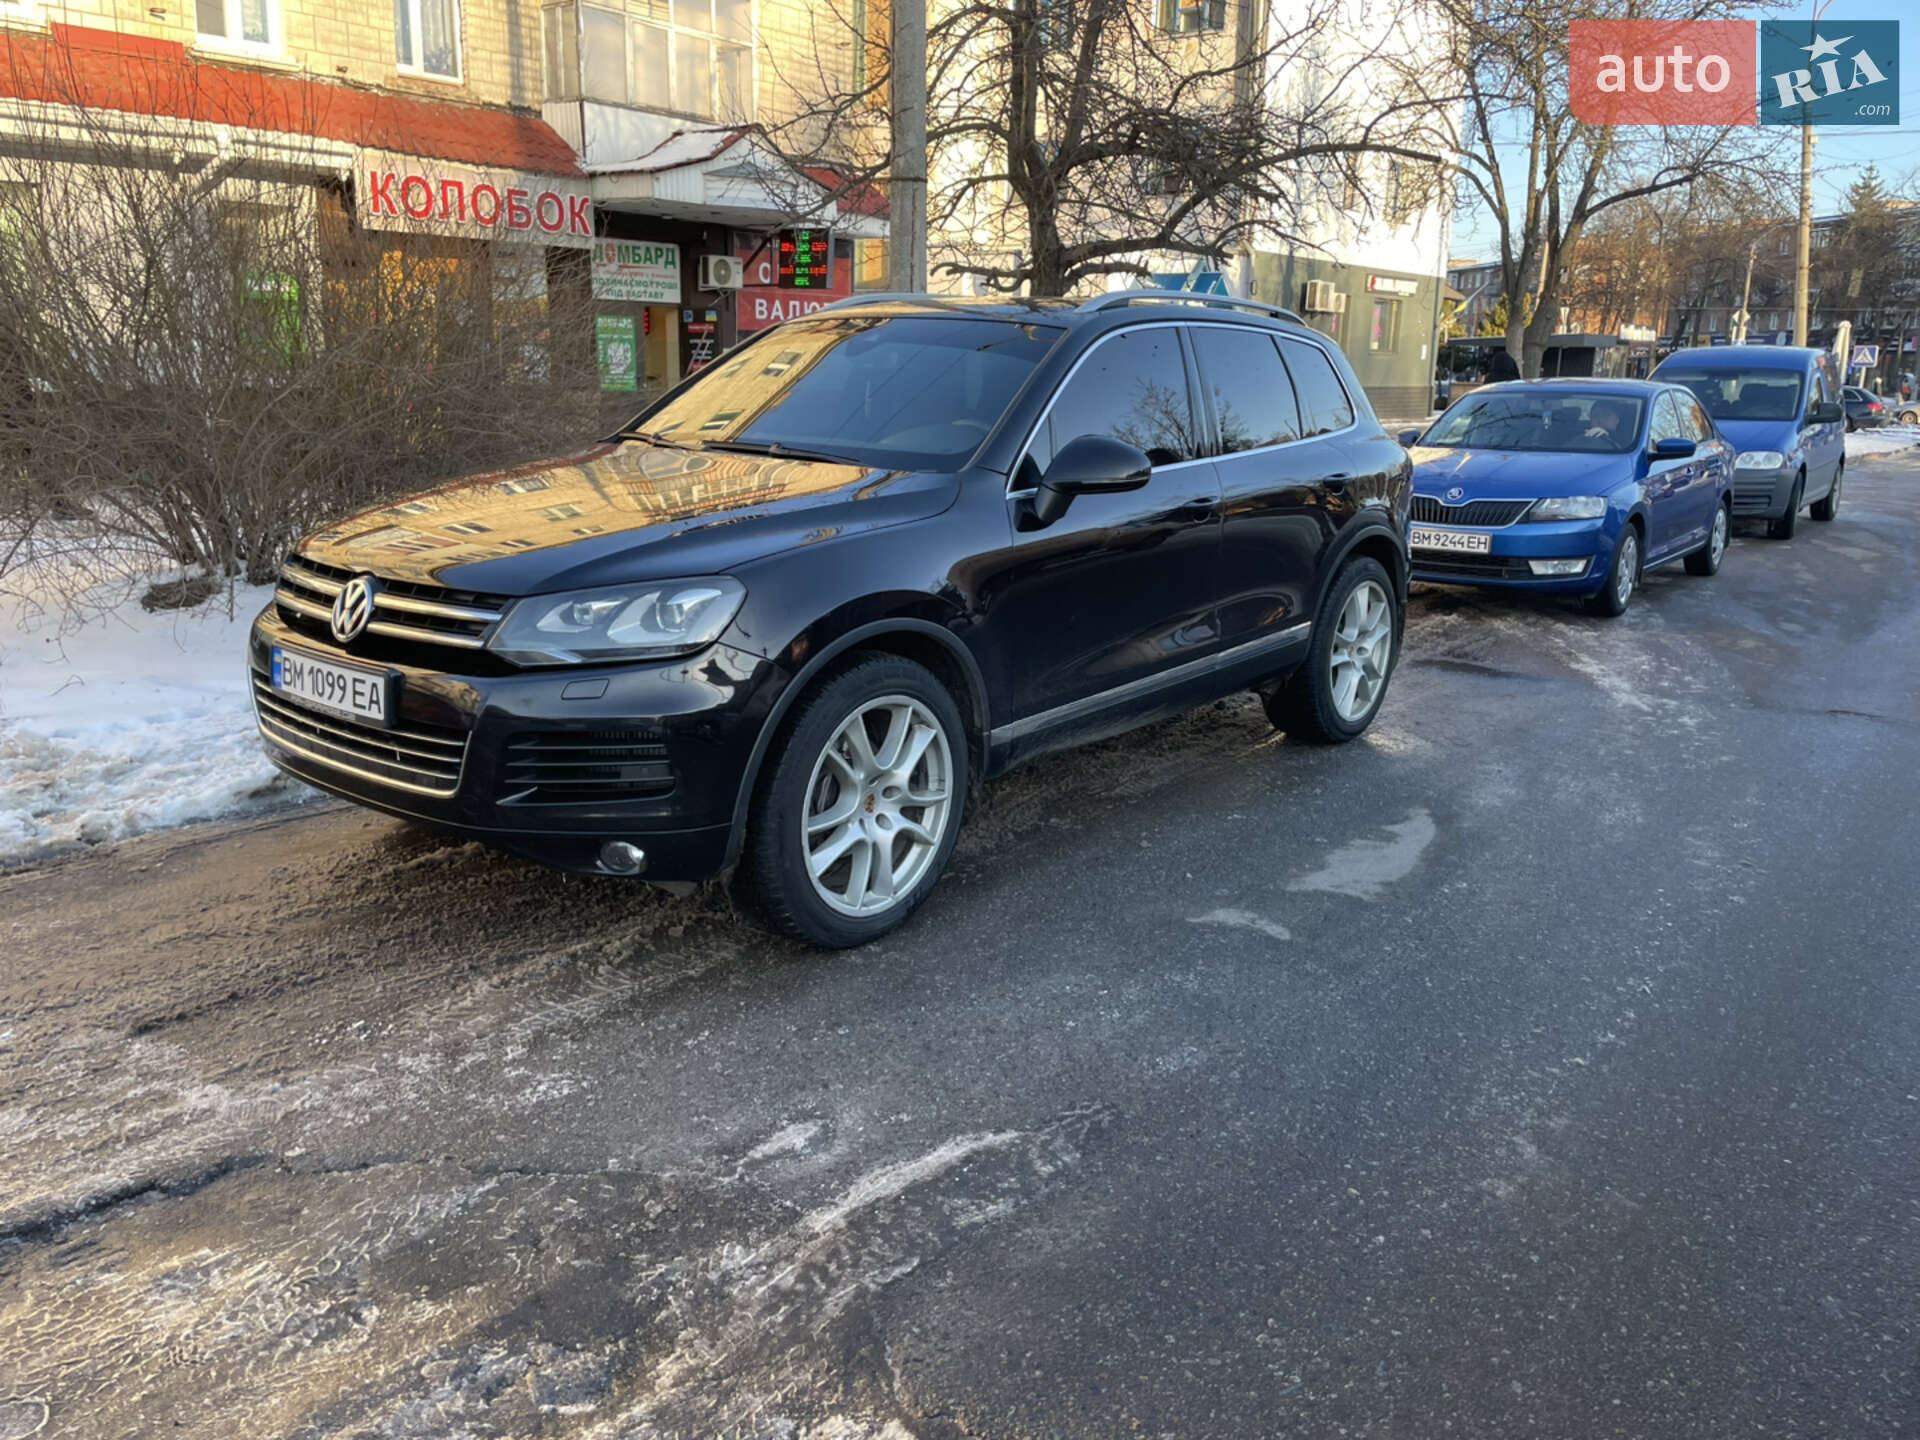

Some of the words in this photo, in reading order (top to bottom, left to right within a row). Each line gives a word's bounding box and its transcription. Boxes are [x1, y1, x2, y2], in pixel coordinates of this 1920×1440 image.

[369, 171, 592, 237] КОЛОБОК
[591, 243, 677, 269] ЛОМБАРД
[755, 298, 835, 321] ВАЛЮ
[1433, 533, 1465, 548] 9244
[308, 666, 347, 704] 1099
